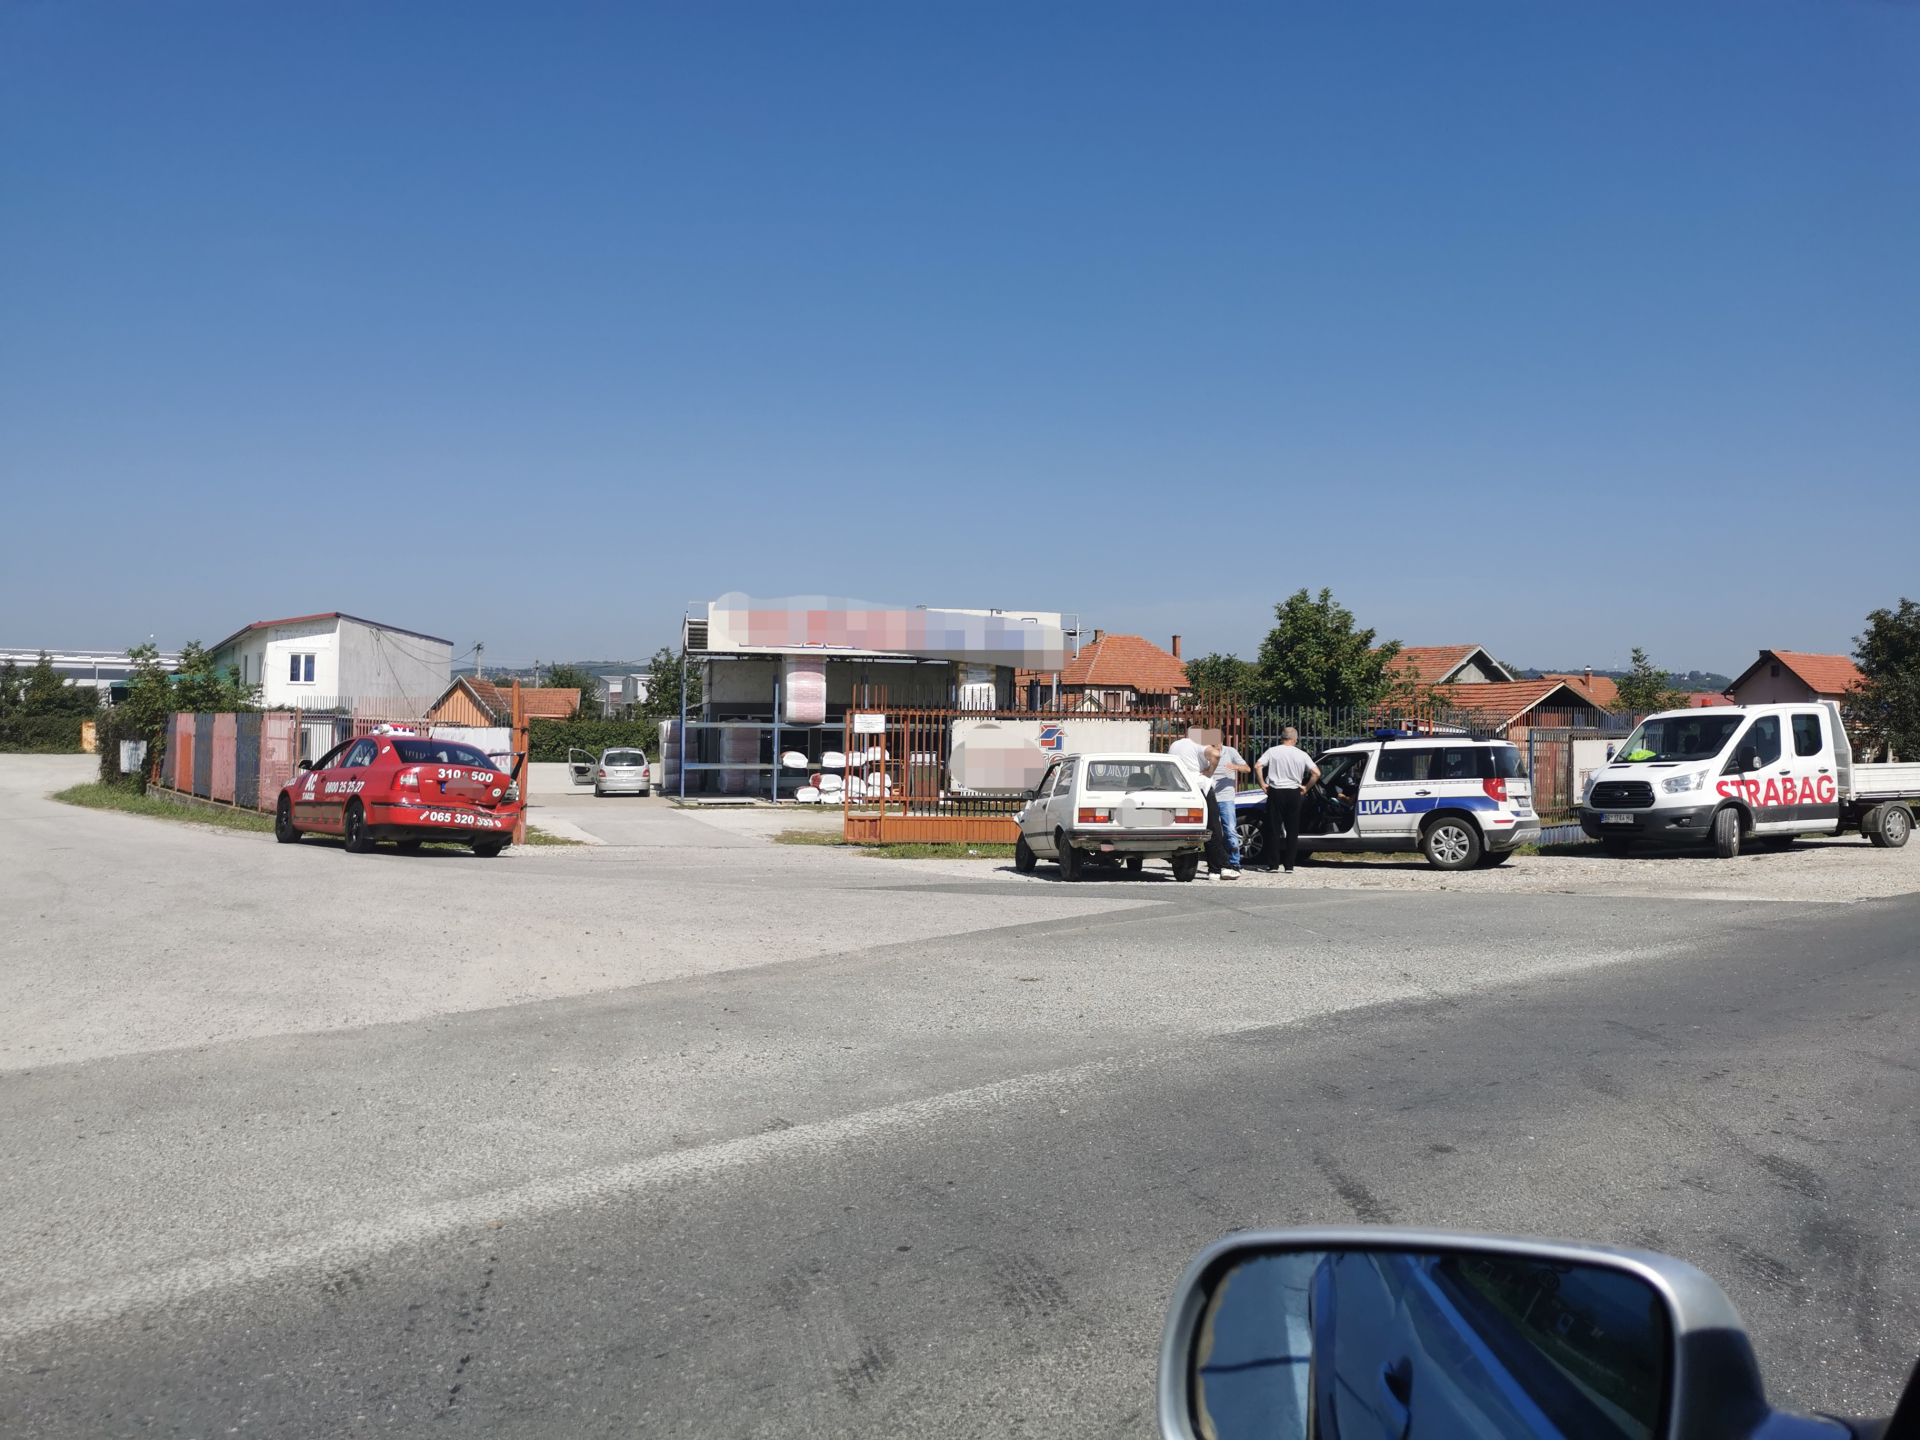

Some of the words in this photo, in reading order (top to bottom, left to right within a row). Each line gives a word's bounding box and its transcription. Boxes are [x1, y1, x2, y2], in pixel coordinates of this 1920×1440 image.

[438, 768, 461, 779] 310
[471, 771, 494, 783] 500
[325, 782, 339, 793] 0800
[338, 781, 347, 793] 25
[354, 781, 365, 793] 27
[1716, 775, 1836, 807] STRABAG
[430, 811, 452, 823] 065
[454, 814, 475, 824] 320
[477, 817, 494, 827] 333
